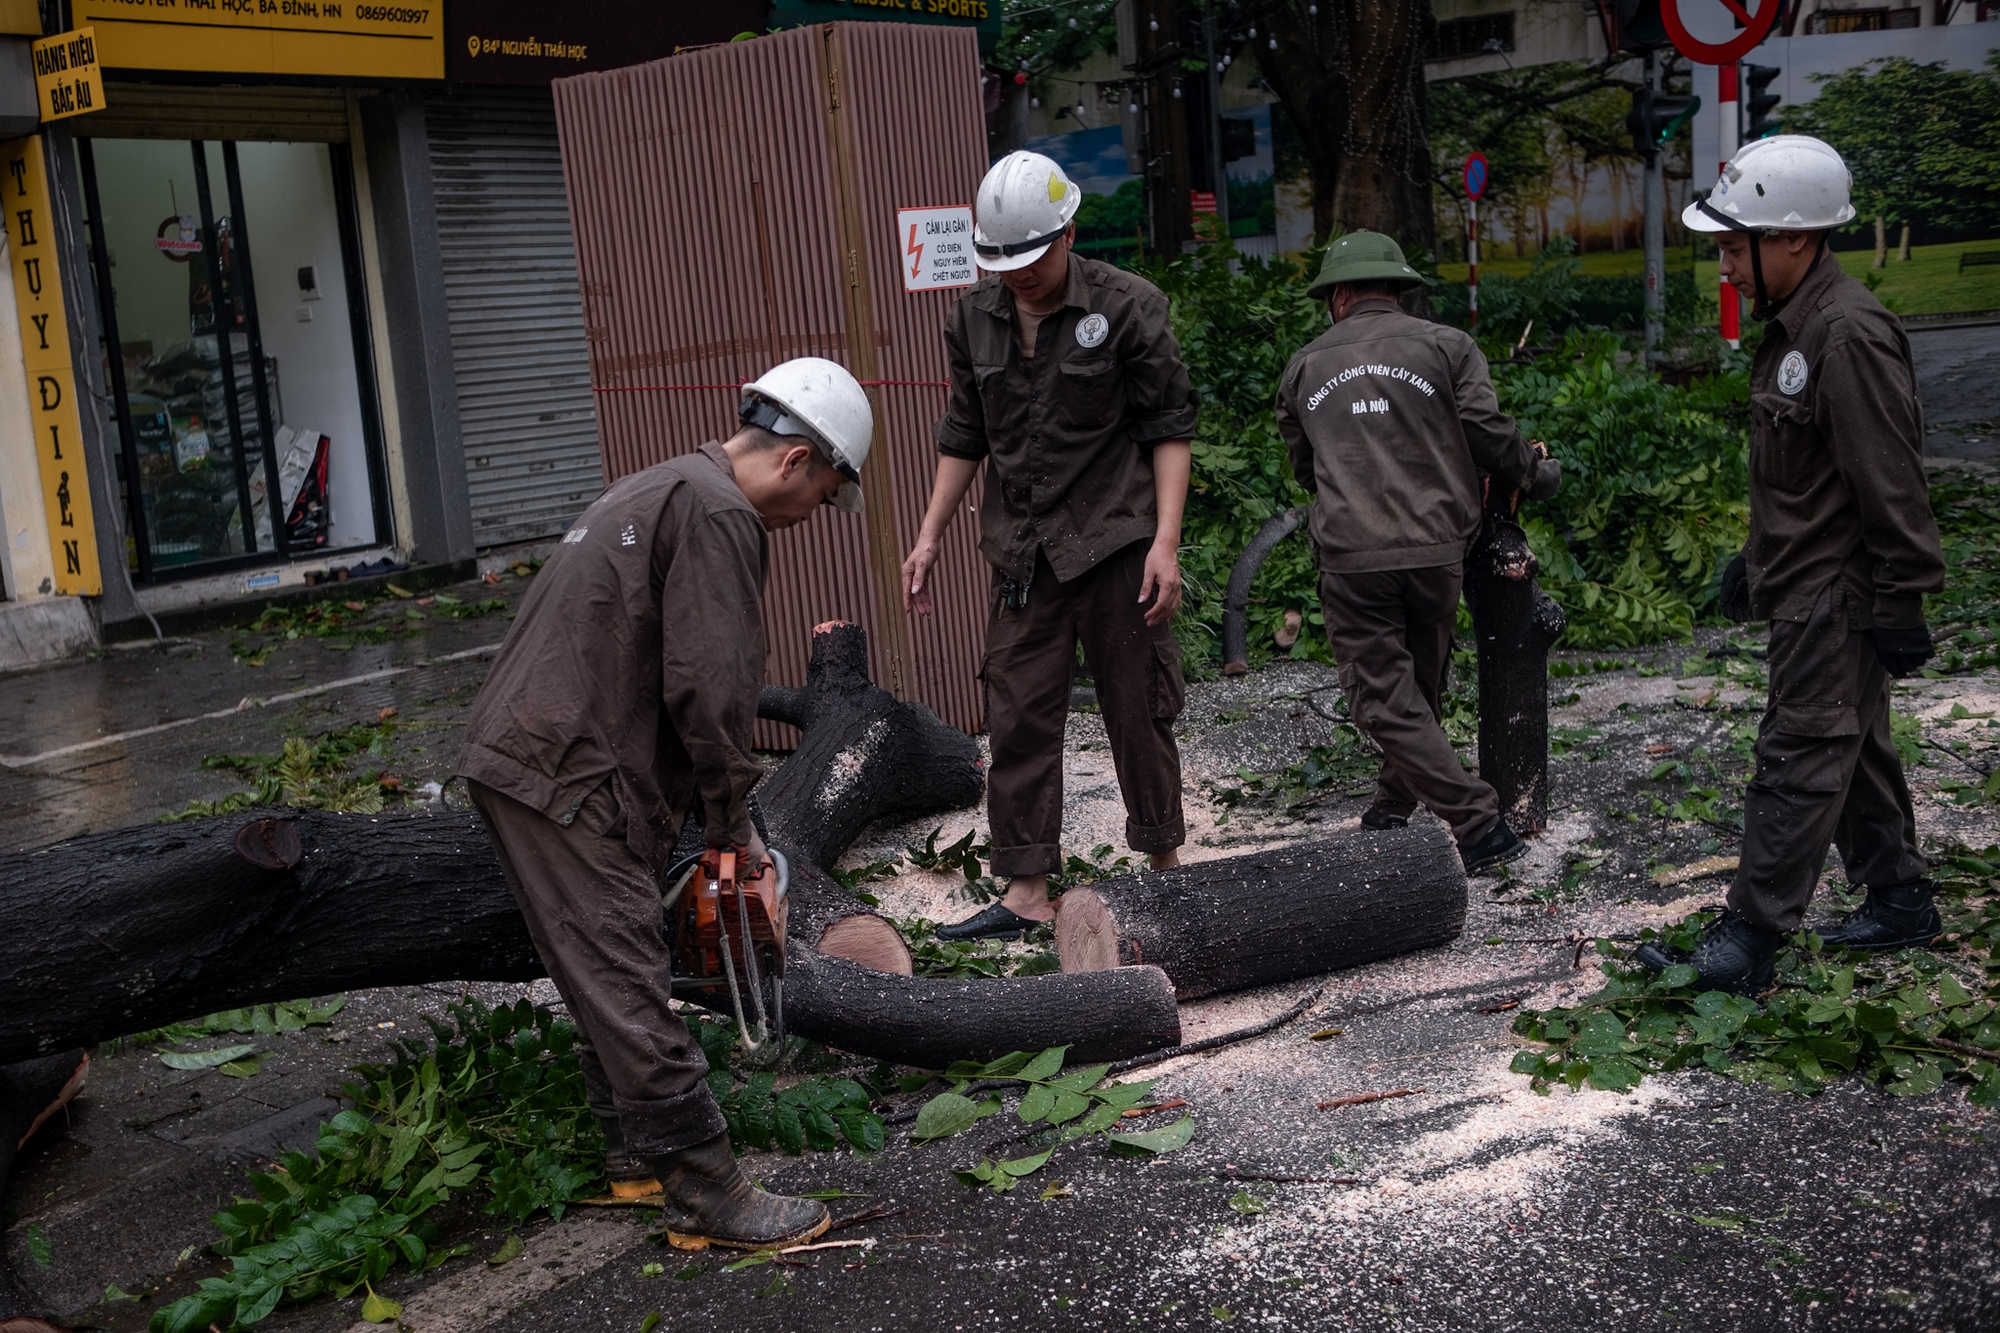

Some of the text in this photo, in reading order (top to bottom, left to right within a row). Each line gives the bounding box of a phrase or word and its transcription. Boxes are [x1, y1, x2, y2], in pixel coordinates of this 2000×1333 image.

[323, 3, 341, 18] HN
[356, 4, 429, 23] 0869601997
[927, 0, 989, 19] SPORTS
[36, 34, 95, 76] HÀNG HIỆU
[501, 35, 542, 57] NGUYỄN
[543, 40, 567, 58] THÁI
[567, 44, 588, 62] HỌC
[51, 78, 92, 115] BẮC ÂU
[10, 160, 50, 349] THỤY
[157, 239, 201, 250] Welcome
[933, 257, 951, 268] NGUY
[1306, 363, 1436, 411] CÔNG TY CÔNG VIÊN CÂY XANH
[1352, 397, 1390, 415] HÀ NỘI
[39, 376, 81, 575] ĐIỂN
